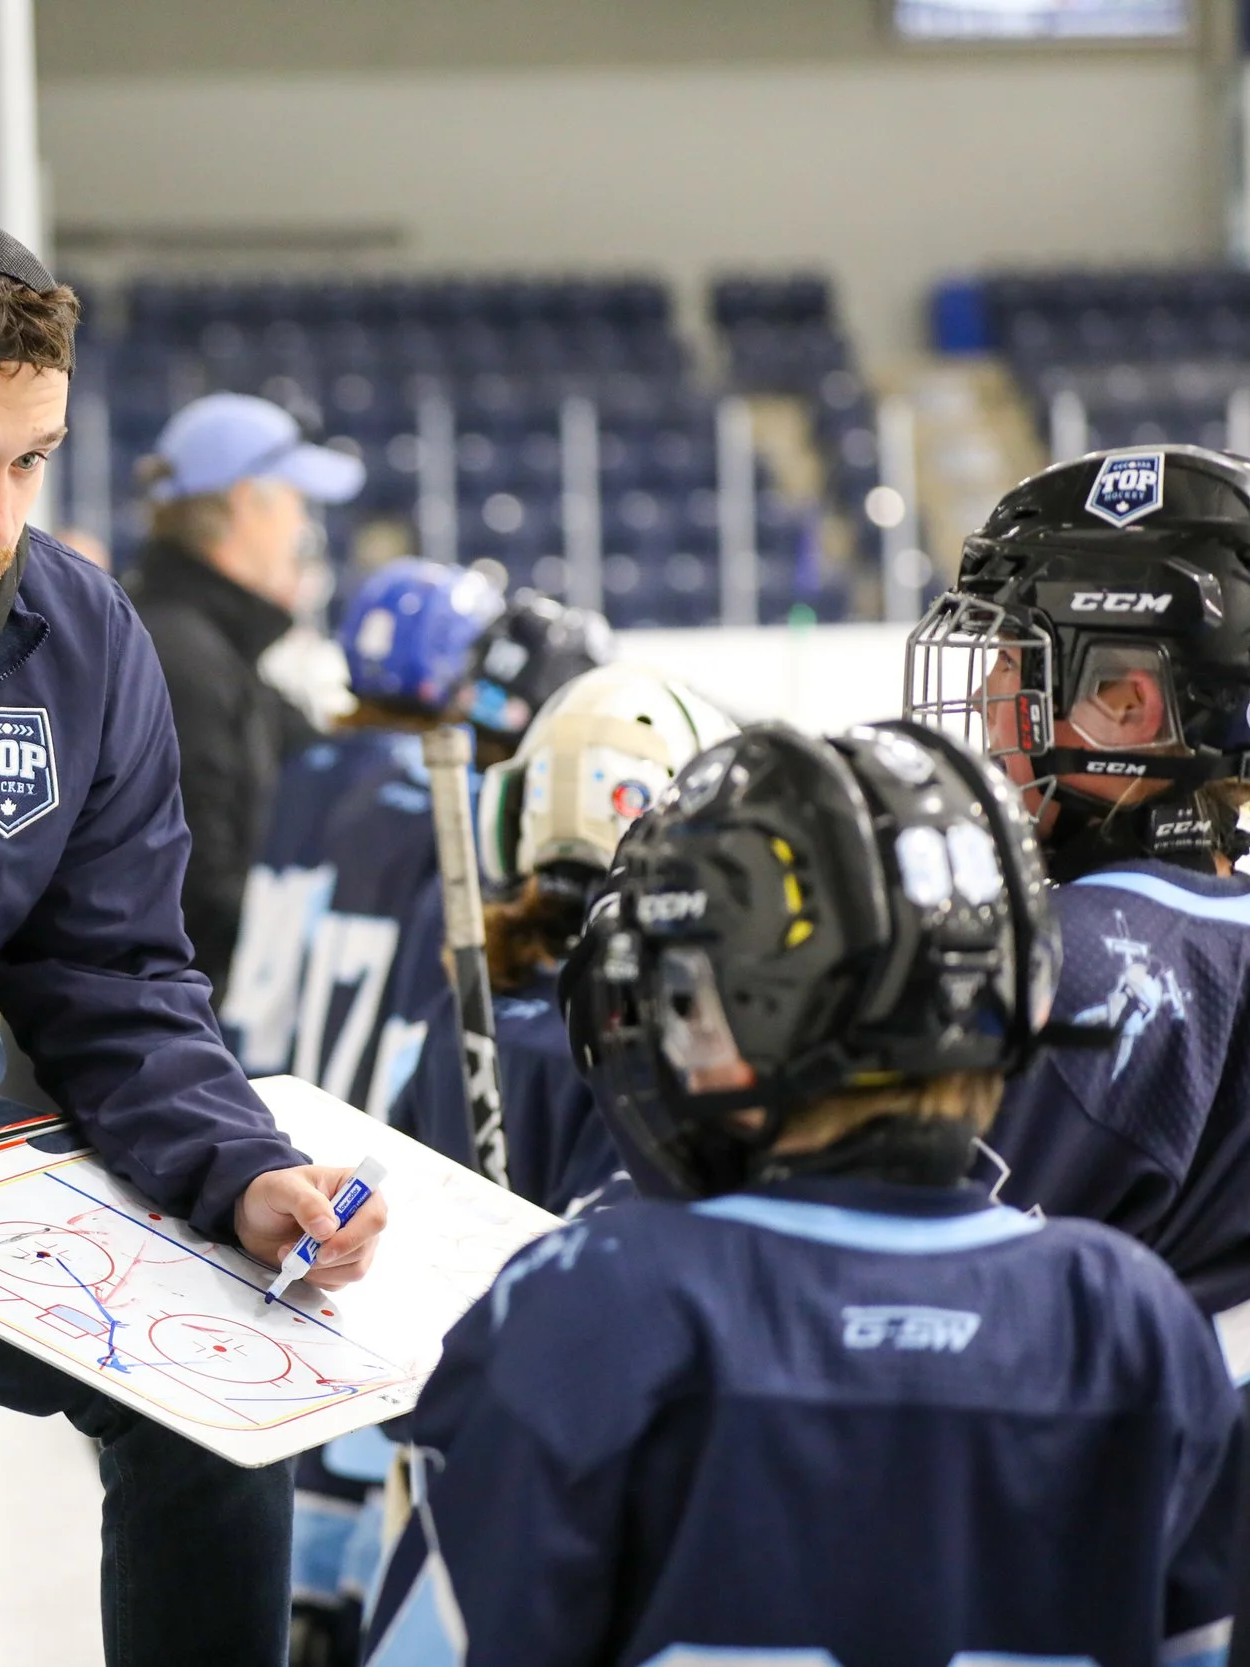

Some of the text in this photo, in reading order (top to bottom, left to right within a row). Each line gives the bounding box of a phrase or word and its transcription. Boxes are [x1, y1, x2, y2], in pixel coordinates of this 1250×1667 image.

[1100, 469, 1158, 494] TOP
[1071, 592, 1173, 613] CCM
[1086, 761, 1147, 776] CCM
[1155, 820, 1212, 837] CCM
[338, 1200, 349, 1212] low
[347, 1187, 359, 1202] odor
